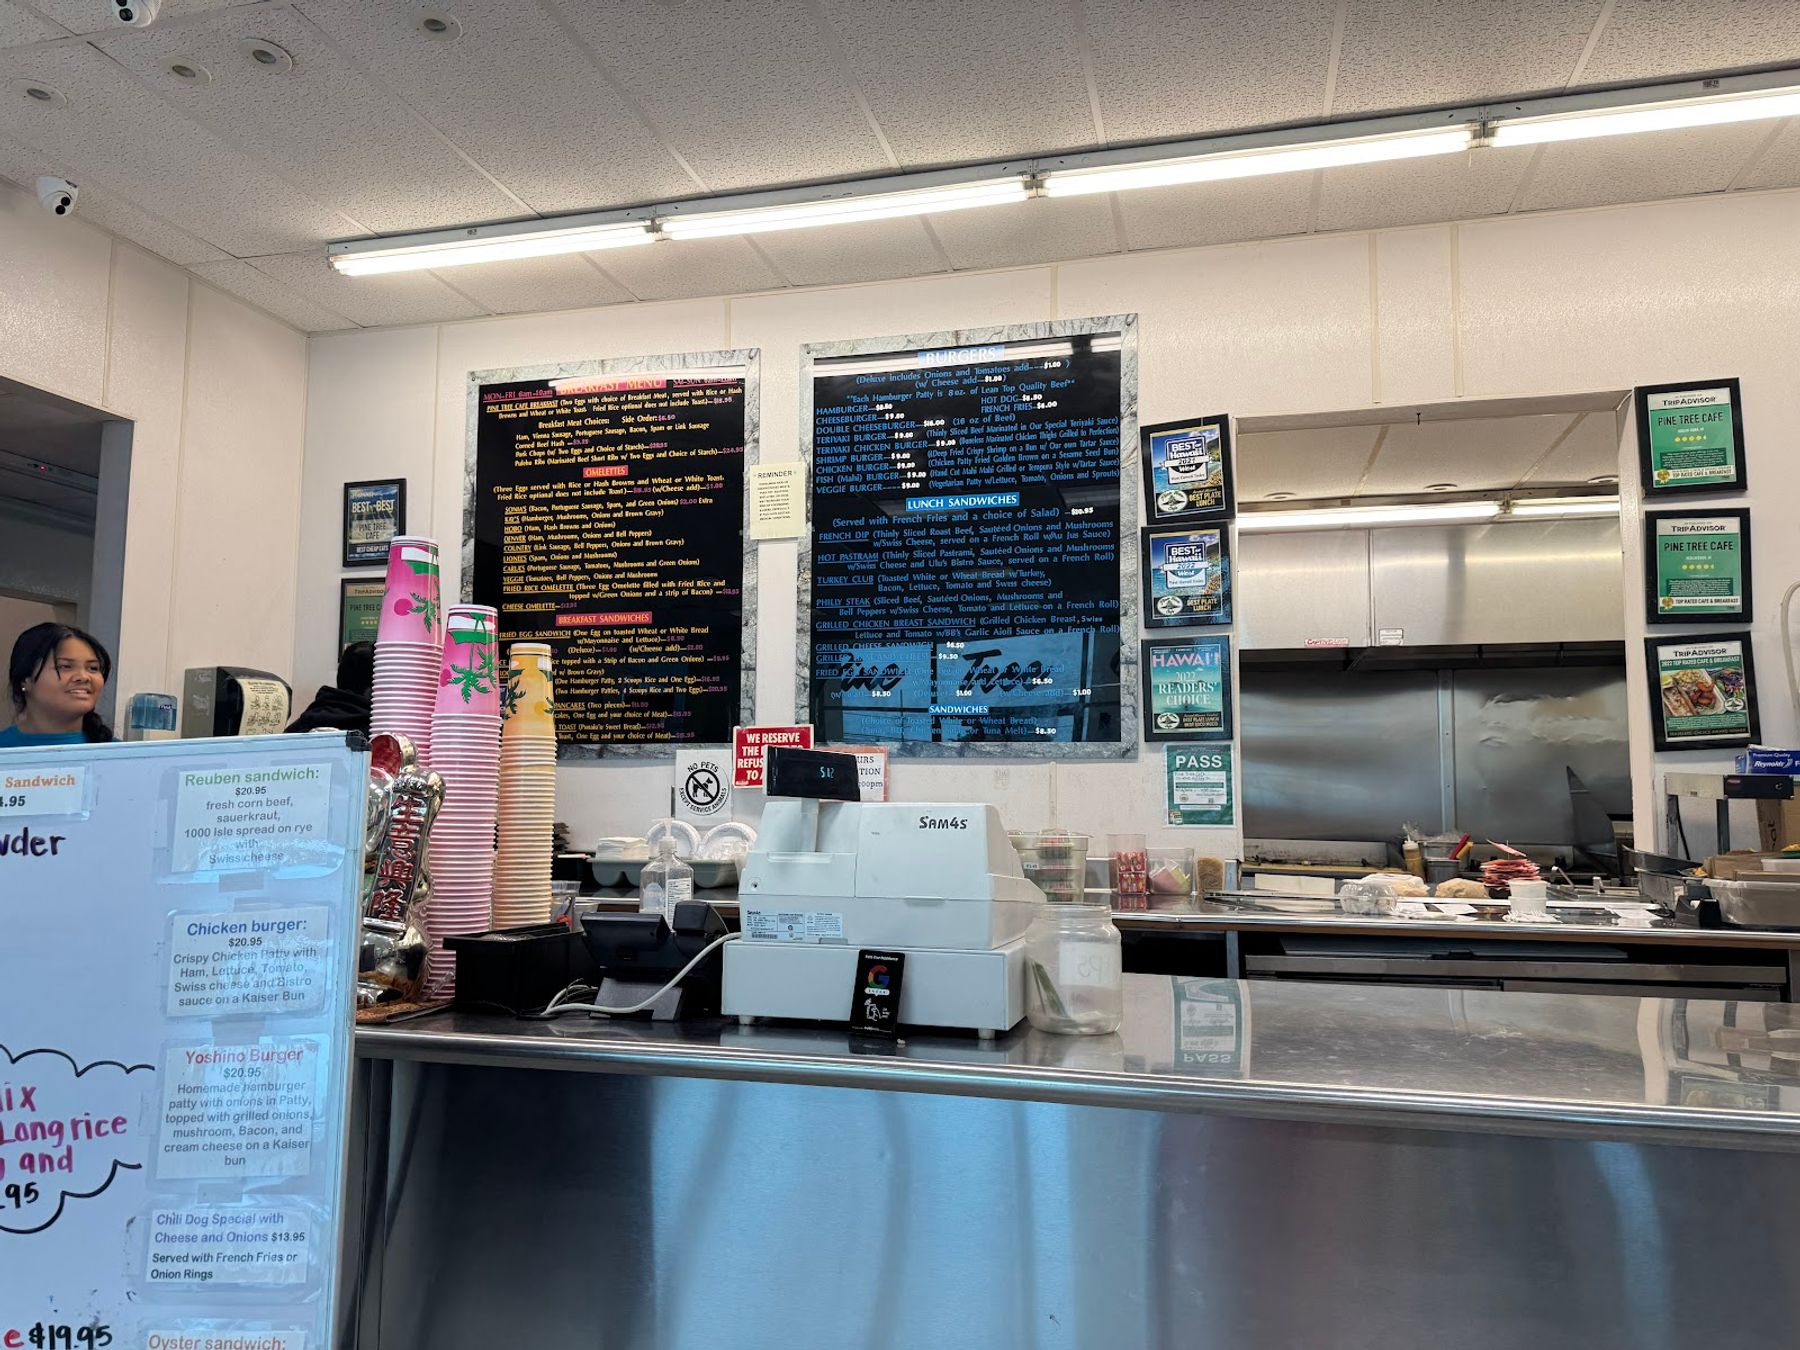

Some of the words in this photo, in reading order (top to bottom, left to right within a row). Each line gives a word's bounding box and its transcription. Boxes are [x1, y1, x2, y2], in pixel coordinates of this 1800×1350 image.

[926, 348, 996, 365] BURGERS
[981, 396, 997, 404] HOT
[981, 404, 1010, 413] FRENCH
[1658, 416, 1677, 426] PINE
[1679, 414, 1700, 424] TREE
[1702, 411, 1724, 423] CAFE
[1171, 441, 1197, 450] BEST
[585, 467, 626, 477] OMELETTES
[758, 470, 792, 478] REMINDER
[352, 502, 370, 513] BEST
[376, 500, 394, 511] BEST
[908, 499, 944, 510] LUNCH
[948, 495, 1017, 508] SANDWICHES
[832, 517, 865, 528] (Served
[870, 516, 888, 525] with
[892, 514, 922, 524] French
[927, 512, 948, 522] Fries
[952, 512, 968, 520] and
[982, 510, 1012, 520] choice
[1017, 508, 1026, 518] of
[1030, 507, 1060, 518] Salad)
[1171, 546, 1196, 556] BEST
[1664, 542, 1684, 552] PINE
[1687, 541, 1708, 550] TREE
[1710, 540, 1734, 550] CAFE
[558, 614, 598, 625] BREAKFAST
[600, 612, 650, 624] SANDWICHES
[1166, 694, 1210, 706] CHOICE
[930, 705, 988, 714] SANDWICHES
[746, 733, 762, 744] WE
[762, 732, 800, 743] RESERVE
[742, 746, 758, 756] THE
[738, 758, 763, 768] REFUS
[857, 756, 874, 764] URS
[1176, 755, 1222, 768] PASS
[1754, 760, 1785, 768] Reynolds
[688, 763, 698, 773] NO
[701, 762, 719, 773] PETS
[5, 774, 76, 788] Sandwich
[185, 773, 240, 786] Reuben
[245, 768, 320, 783] sandwich:
[746, 770, 759, 780] TO
[235, 786, 266, 796] $20.95
[206, 799, 234, 810] fresh
[238, 799, 263, 809] corn
[266, 796, 294, 808] beef,
[680, 788, 690, 808] EXCEPT
[690, 803, 711, 814] SERVICE
[709, 788, 727, 810] ANIMALS
[217, 811, 280, 823] sauerkraut,
[185, 828, 210, 838] 1000
[214, 826, 233, 837] Isle
[236, 824, 275, 837] spread
[278, 825, 292, 834] on
[294, 824, 313, 834] rye
[236, 838, 258, 849] with
[210, 854, 240, 864] Swiss
[244, 851, 284, 862] cheese
[187, 922, 247, 936] Chicken
[252, 920, 308, 934] burger:
[228, 937, 262, 948] $20.95
[174, 953, 210, 966] Crispy
[212, 950, 258, 962] Chicken
[261, 949, 290, 960] Patty
[293, 947, 317, 958] with
[180, 967, 208, 978] Ham,
[212, 965, 258, 977] Lettuce,
[262, 963, 308, 974] Tomato,
[174, 982, 206, 993] Swiss
[210, 980, 250, 990] cheese
[253, 978, 274, 988] and
[277, 976, 312, 987] Bistro
[178, 997, 212, 1007] sauce
[215, 996, 229, 1004] on
[232, 996, 239, 1004] a
[242, 992, 280, 1003] Kaiser
[282, 991, 305, 1001] Bun
[186, 1050, 246, 1064] Yoshino
[250, 1050, 304, 1064] Burger
[224, 1068, 262, 1079] $20.95
[178, 1082, 240, 1094] Homemade
[244, 1080, 306, 1092] hamburger
[169, 1098, 197, 1112] patty
[200, 1097, 223, 1108] with
[226, 1096, 263, 1108] onions
[267, 1095, 276, 1106] in
[280, 1094, 312, 1108] Patty,
[166, 1112, 204, 1124] topped
[206, 1111, 230, 1122] with
[233, 1110, 269, 1124] grilled
[272, 1109, 314, 1120] onions,
[173, 1126, 236, 1138] mushroom,
[239, 1125, 278, 1137] Bacon,
[282, 1124, 303, 1134] and
[164, 1144, 200, 1152] cream
[202, 1140, 242, 1151] cheese
[246, 1141, 260, 1150] on
[263, 1141, 270, 1150] a
[274, 1139, 310, 1150] Kaiser
[20, 1144, 73, 1174] and
[224, 1155, 246, 1166] bun
[156, 1212, 183, 1226] Chili
[186, 1214, 209, 1228] Dog
[212, 1213, 256, 1226] Special
[260, 1213, 284, 1224] with
[155, 1232, 198, 1244] Cheese
[202, 1232, 223, 1242] and
[226, 1232, 268, 1242] Onions
[272, 1232, 305, 1242] $13.95
[152, 1252, 190, 1263] Served
[192, 1252, 213, 1262] with
[216, 1252, 254, 1262] French
[256, 1252, 284, 1262] Fries
[286, 1254, 298, 1262] or
[151, 1269, 181, 1280] Onion
[184, 1269, 214, 1281] Rings
[28, 1321, 112, 1350] $19.95
[148, 1335, 199, 1350] Oyster
